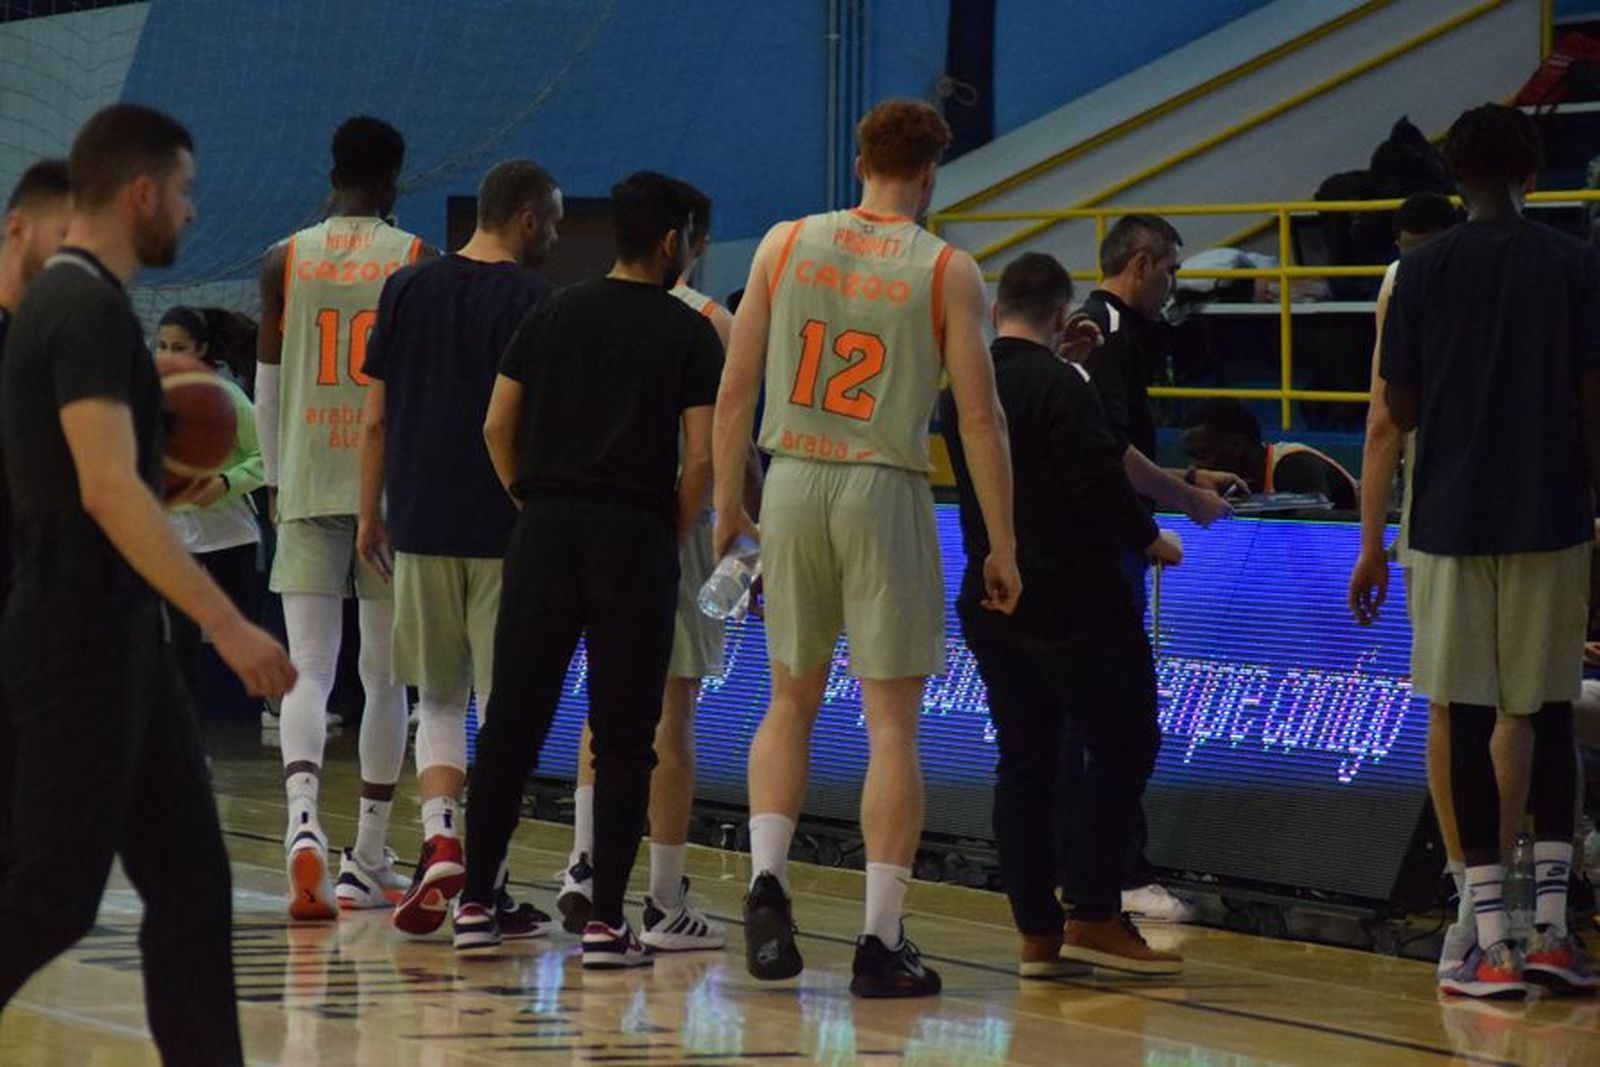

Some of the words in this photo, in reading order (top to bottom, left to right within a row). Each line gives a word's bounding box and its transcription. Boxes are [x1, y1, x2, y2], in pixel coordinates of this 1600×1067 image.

[796, 260, 911, 305] CAZOO
[789, 318, 887, 421] 12
[781, 429, 849, 460] araba
